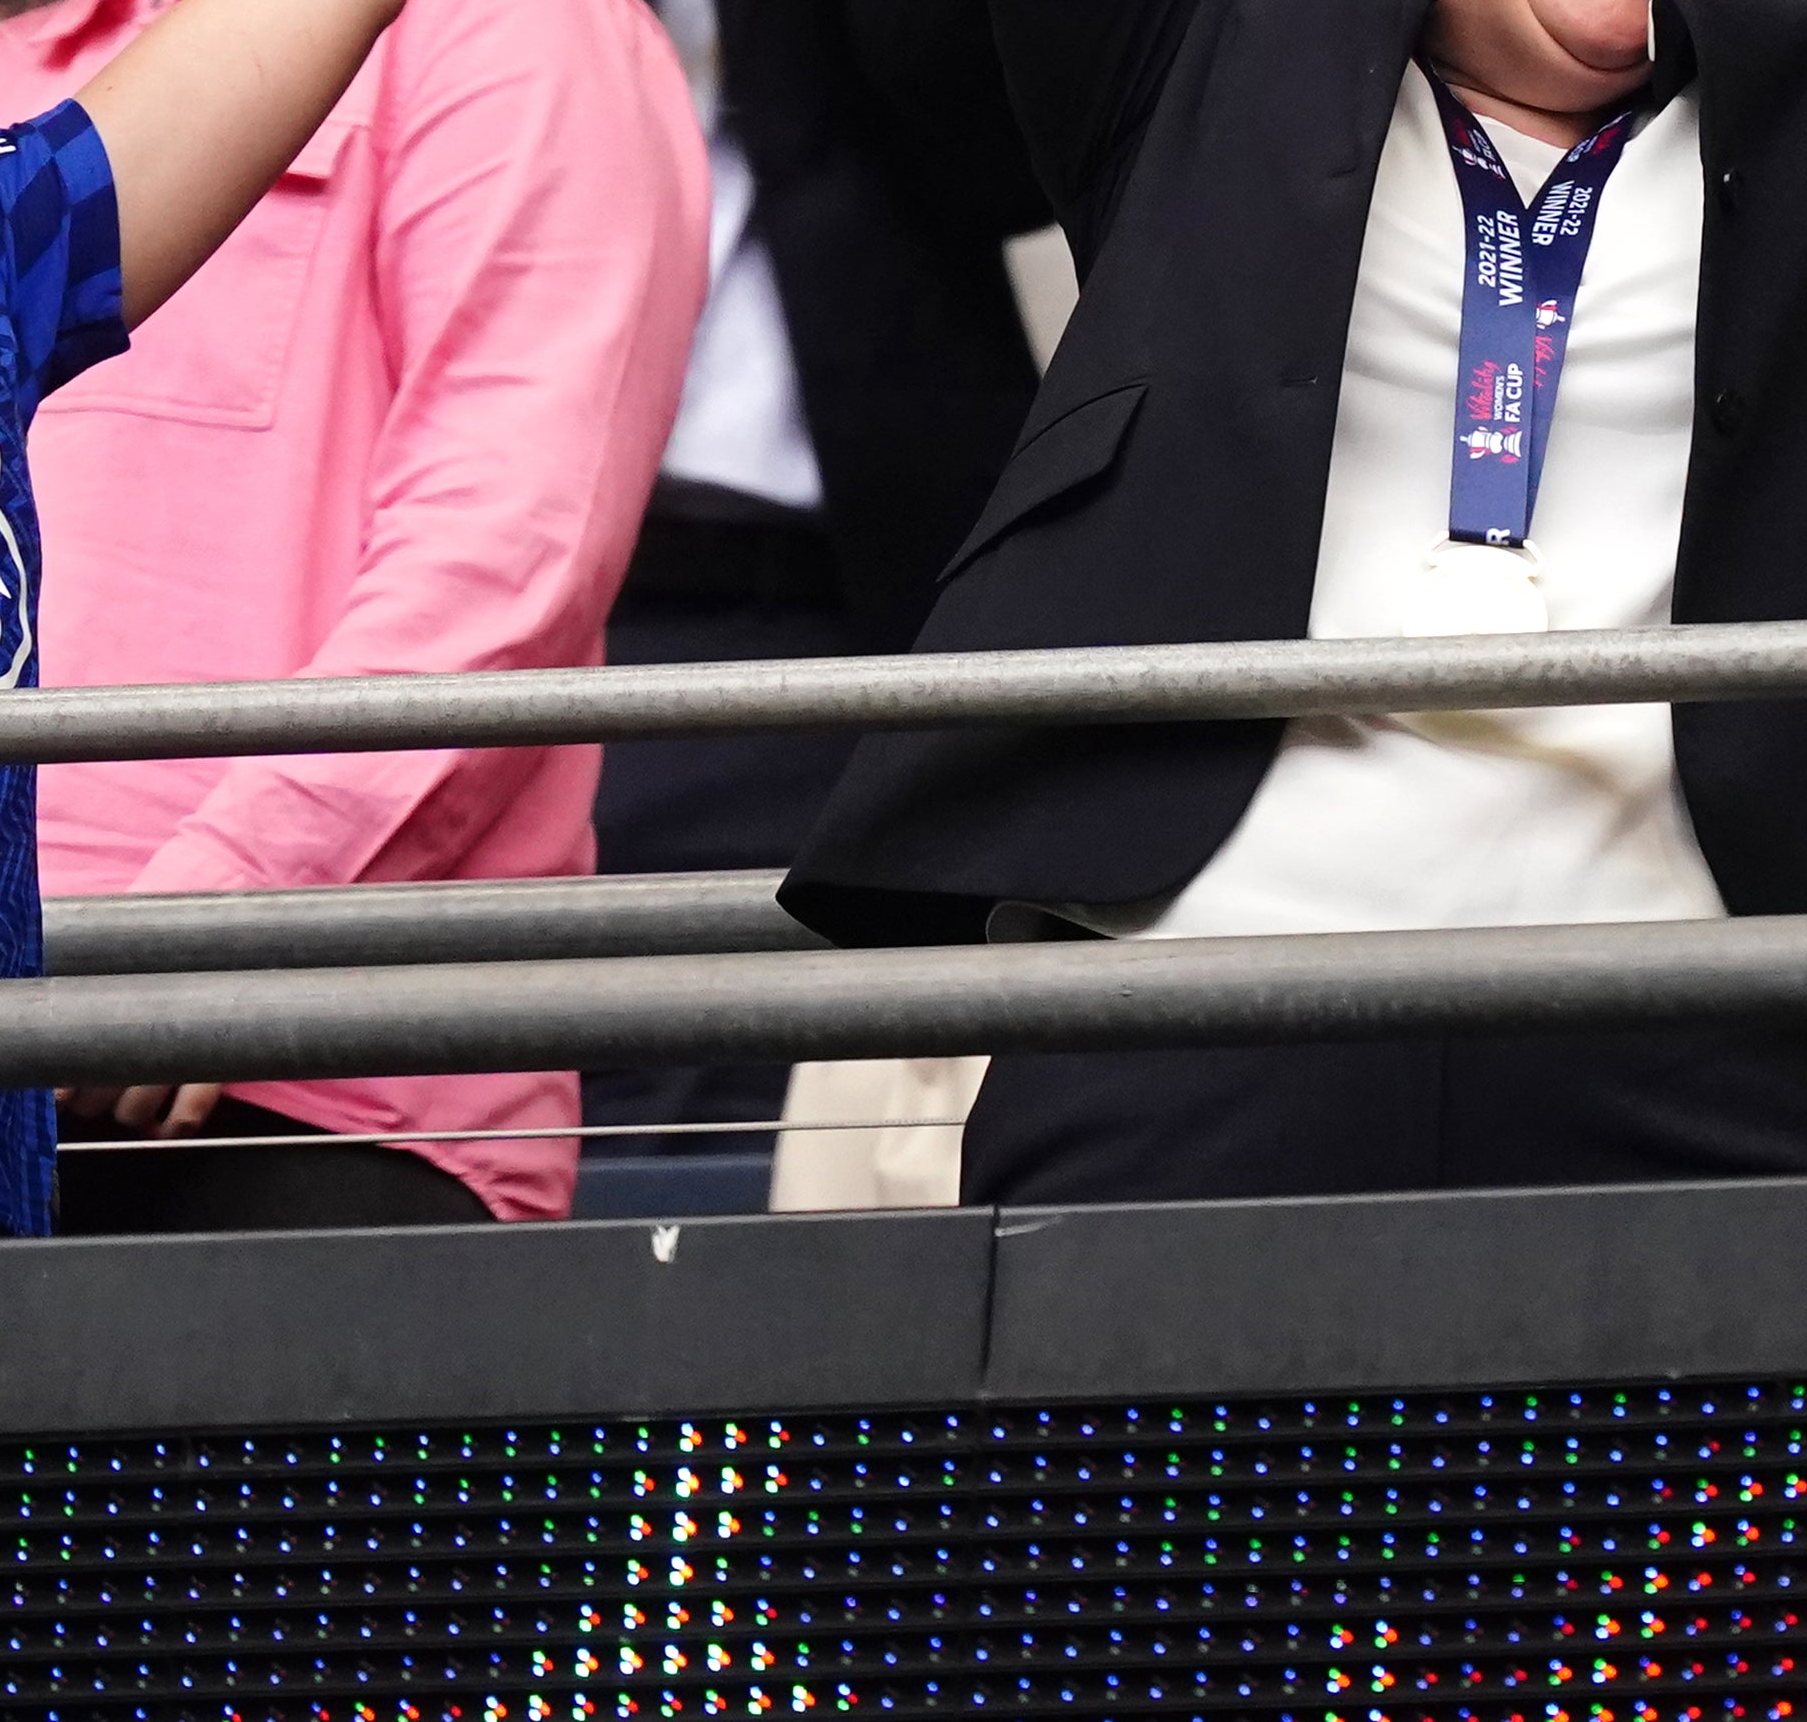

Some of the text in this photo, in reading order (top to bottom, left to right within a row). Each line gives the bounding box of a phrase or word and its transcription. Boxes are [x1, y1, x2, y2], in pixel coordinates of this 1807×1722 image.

[1531, 179, 1575, 246] WINNER
[1560, 186, 1593, 236] 2021-22
[1477, 214, 1495, 288] 2021-22
[1496, 209, 1524, 307] WINNER
[1465, 359, 1501, 422] Vitality
[1494, 375, 1505, 421] WOMEN'S
[1504, 362, 1524, 423] FA CUP
